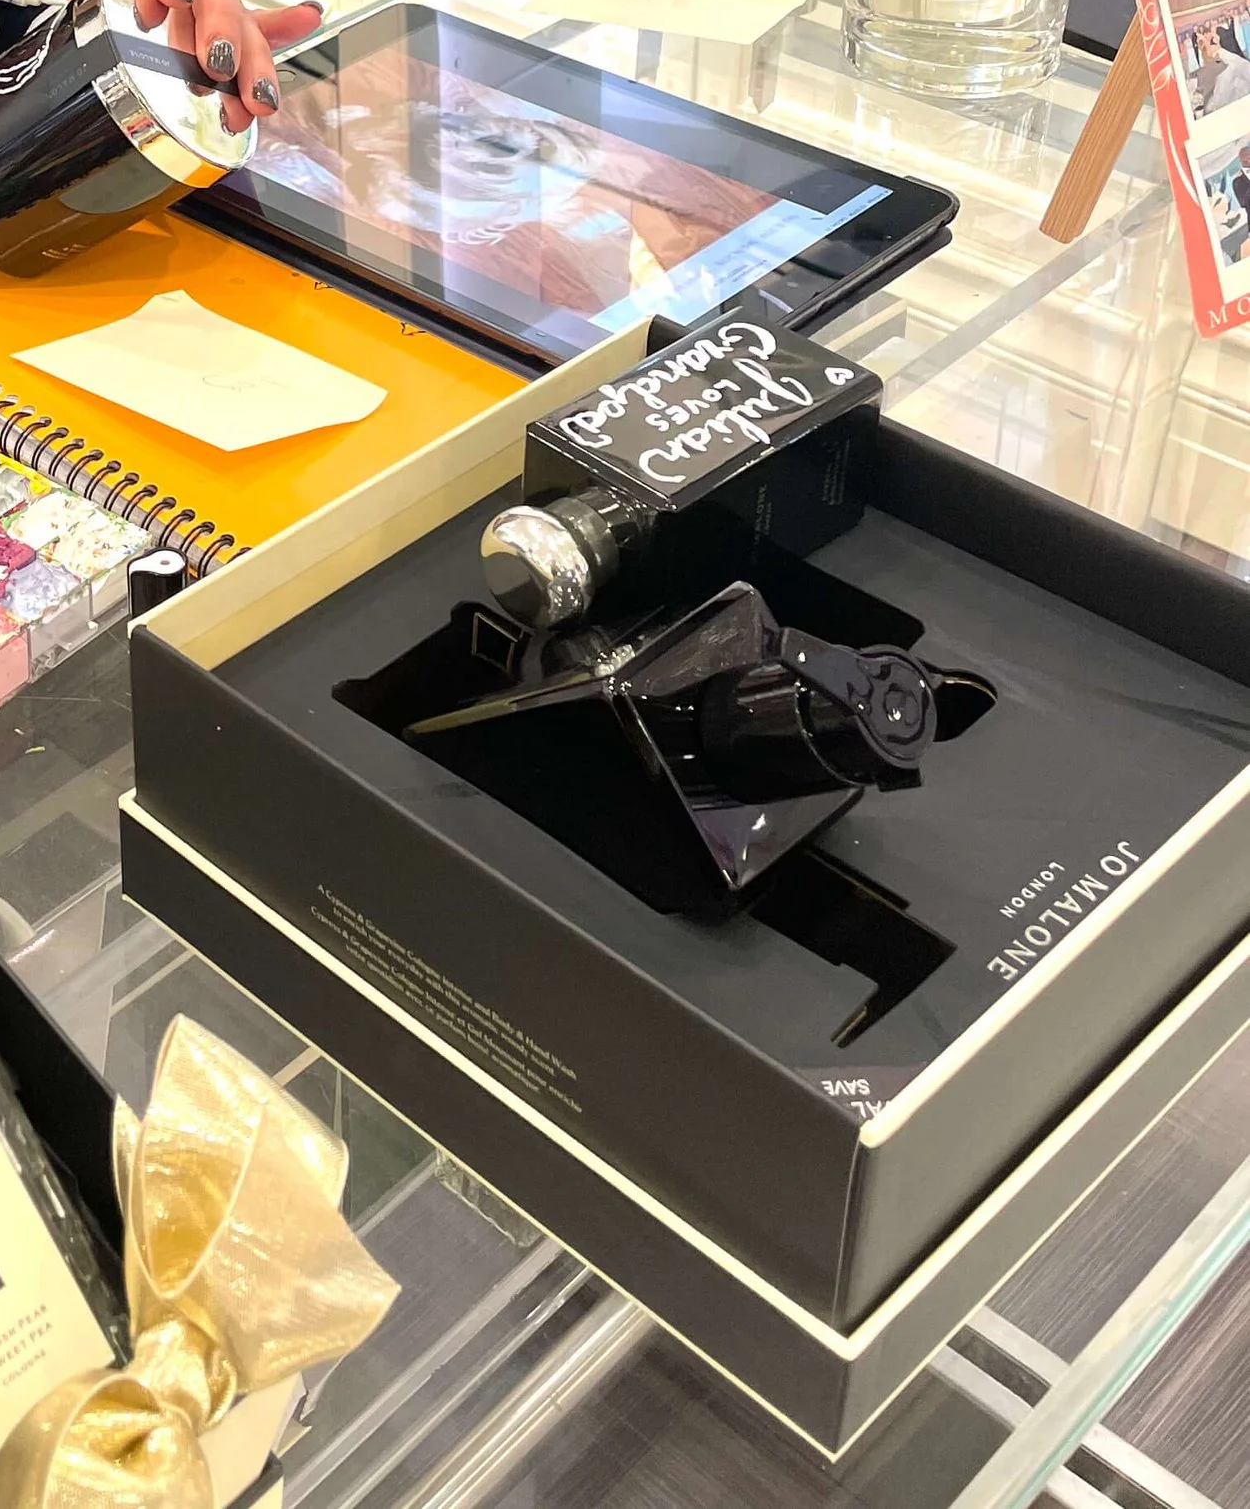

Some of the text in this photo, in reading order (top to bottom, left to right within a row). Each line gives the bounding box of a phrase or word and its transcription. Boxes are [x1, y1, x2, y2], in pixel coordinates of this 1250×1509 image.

[558, 322, 778, 449] Grandpa
[644, 378, 743, 432] LOVES
[638, 358, 814, 484] Julian
[986, 841, 1141, 981] JO MALONE
[999, 861, 1066, 919] LONDON
[820, 1078, 871, 1096] SAVE
[850, 1100, 890, 1118] AL
[17, 1303, 47, 1330] PEAR
[29, 1321, 53, 1343] PEA
